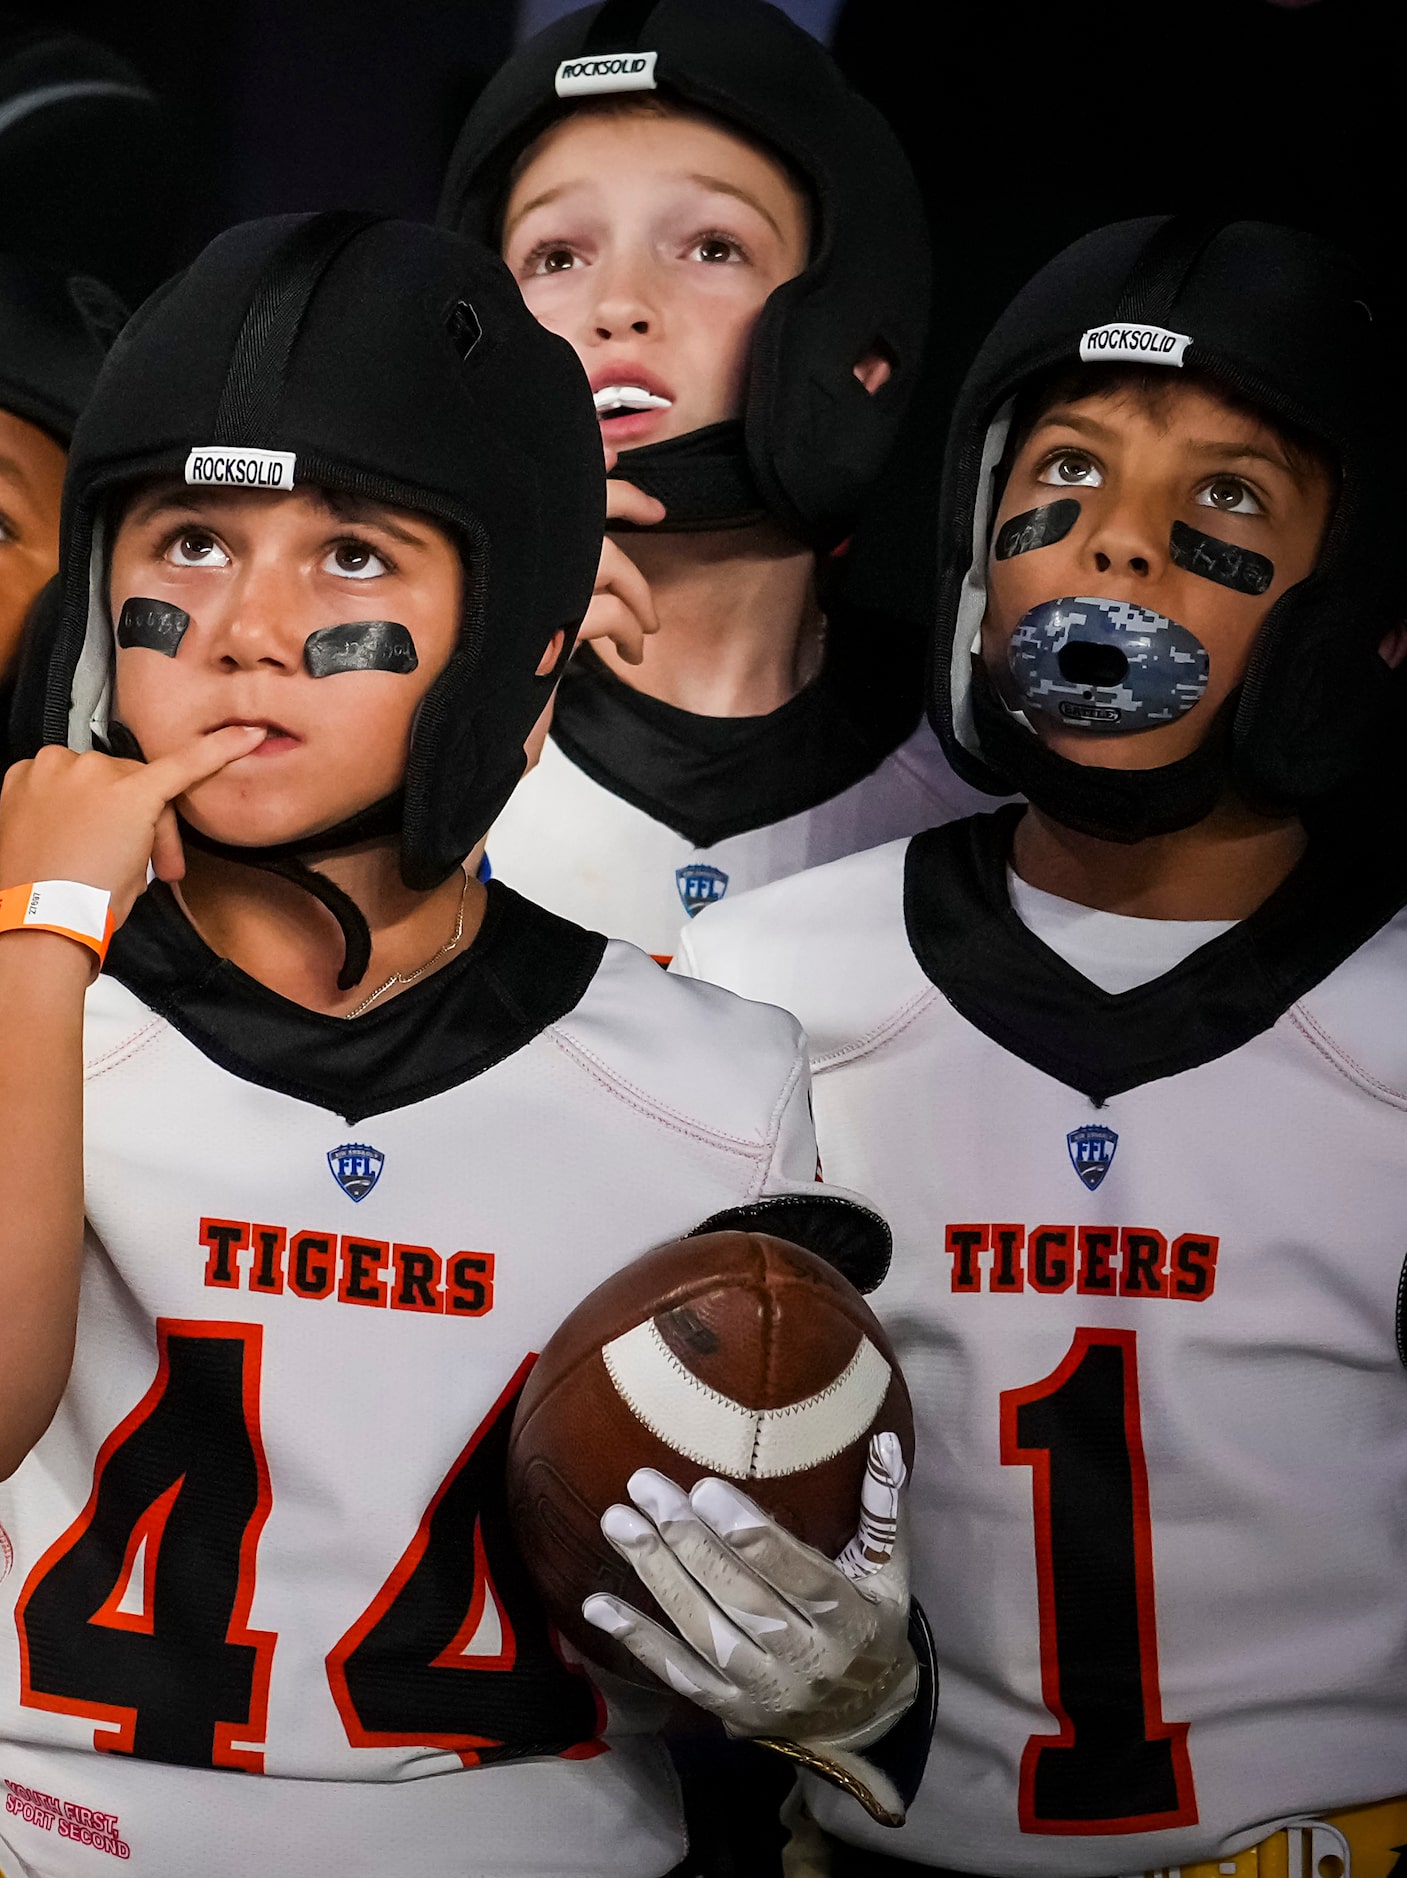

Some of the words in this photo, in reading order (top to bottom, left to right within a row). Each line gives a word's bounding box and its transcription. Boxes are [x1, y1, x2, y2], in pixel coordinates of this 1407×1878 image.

[561, 58, 647, 79] ROCKSOLID
[1087, 329, 1177, 353] ROCKSOLID
[193, 457, 283, 486] ROCKSOLID
[684, 877, 719, 900] FFL
[337, 1157, 376, 1177] FFL
[1076, 1140, 1109, 1161] FFL
[199, 1217, 495, 1318] TIGERS
[945, 1223, 1220, 1302] TIGERS
[14, 1317, 611, 1775] 44
[999, 1326, 1199, 1835] 1
[5, 1793, 55, 1831] SPORT
[58, 1818, 131, 1860] SECOND
[64, 1801, 119, 1840] FIRST,
